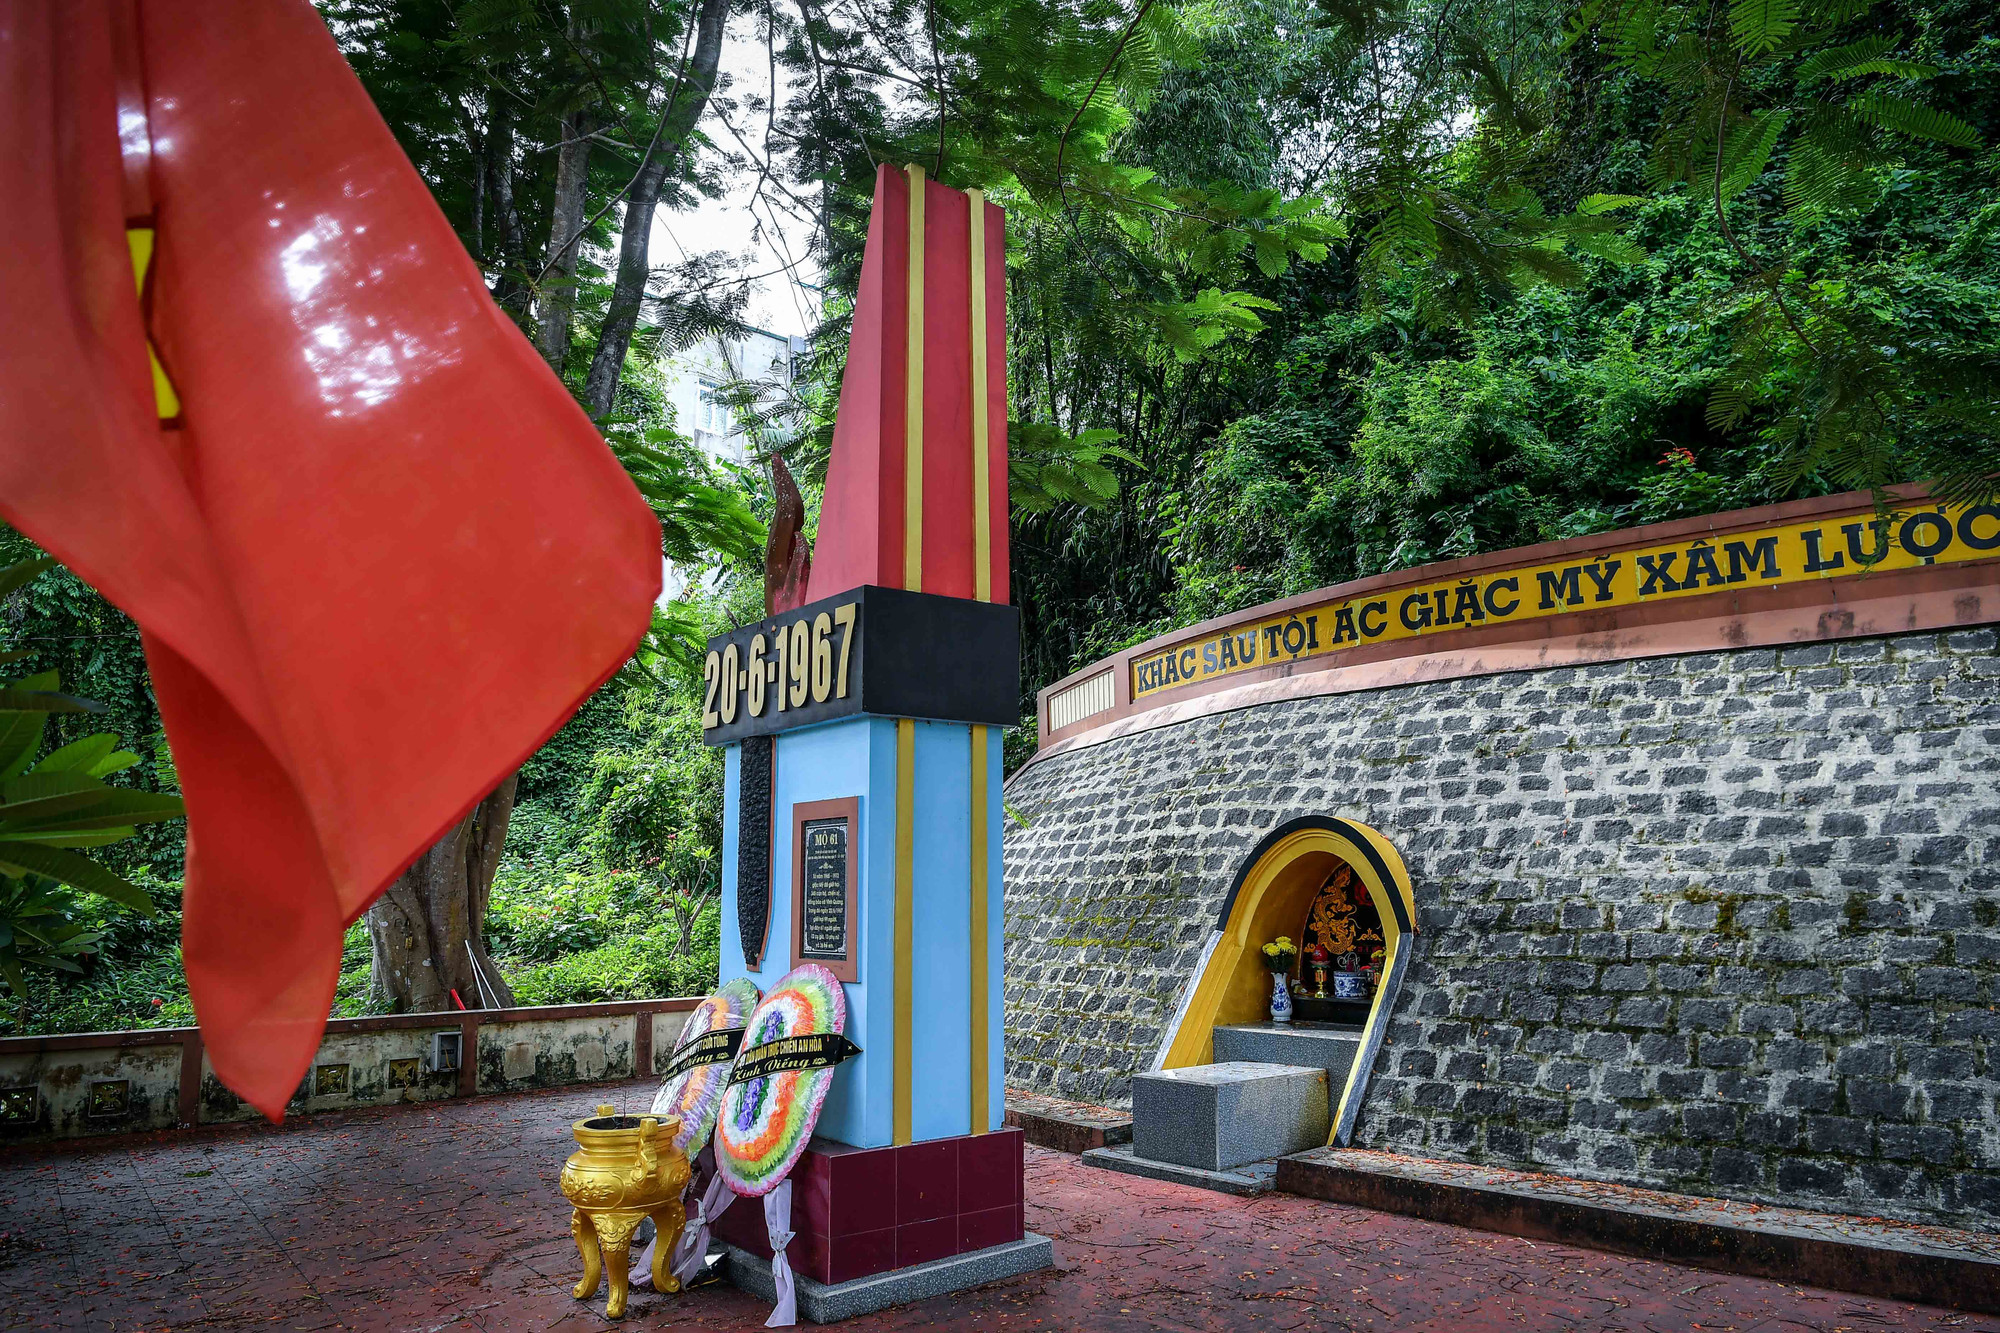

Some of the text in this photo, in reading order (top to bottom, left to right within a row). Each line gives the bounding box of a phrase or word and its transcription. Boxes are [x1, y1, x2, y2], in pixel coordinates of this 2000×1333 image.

[1137, 647, 1196, 693] KHẮC
[1203, 631, 1257, 674] SÂU
[1264, 614, 1319, 659] TỘI
[1332, 601, 1387, 645] ÁC
[1400, 577, 1520, 627] GIẶC
[1537, 555, 1622, 610] MỸ
[1637, 537, 1782, 596] XÂM
[703, 603, 856, 729] 20-6-1967
[815, 831, 839, 848] MỘ 61
[780, 1037, 797, 1054] CHIẾN
[798, 1038, 808, 1053] AN
[809, 1036, 823, 1052] HÒA
